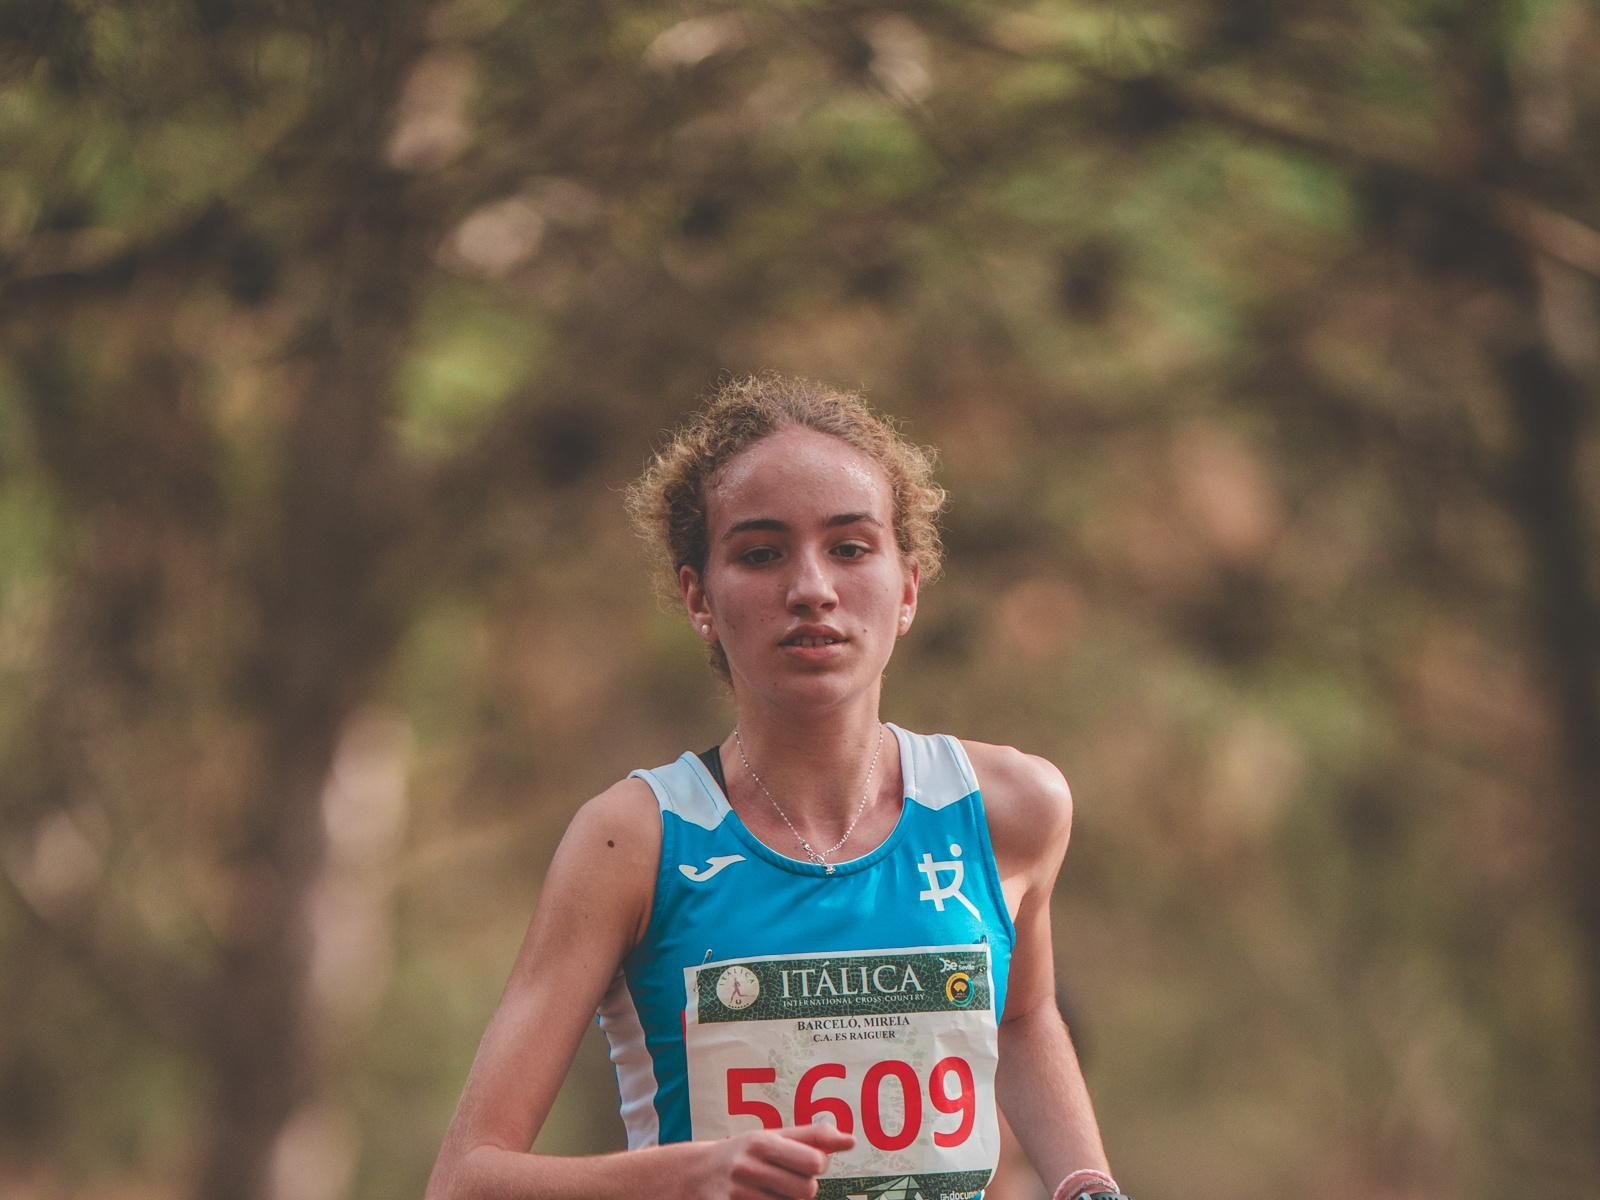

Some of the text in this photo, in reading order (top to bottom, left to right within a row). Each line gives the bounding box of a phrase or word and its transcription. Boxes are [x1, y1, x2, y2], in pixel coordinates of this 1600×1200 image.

[780, 961, 925, 998] ITÁLICA
[782, 993, 926, 1008] INTERNATIONAL CROSS COUNTRY
[864, 1016, 910, 1028] MIREIA
[813, 1030, 896, 1042] C.A. ES RAIGUER
[726, 1056, 976, 1153] 5609
